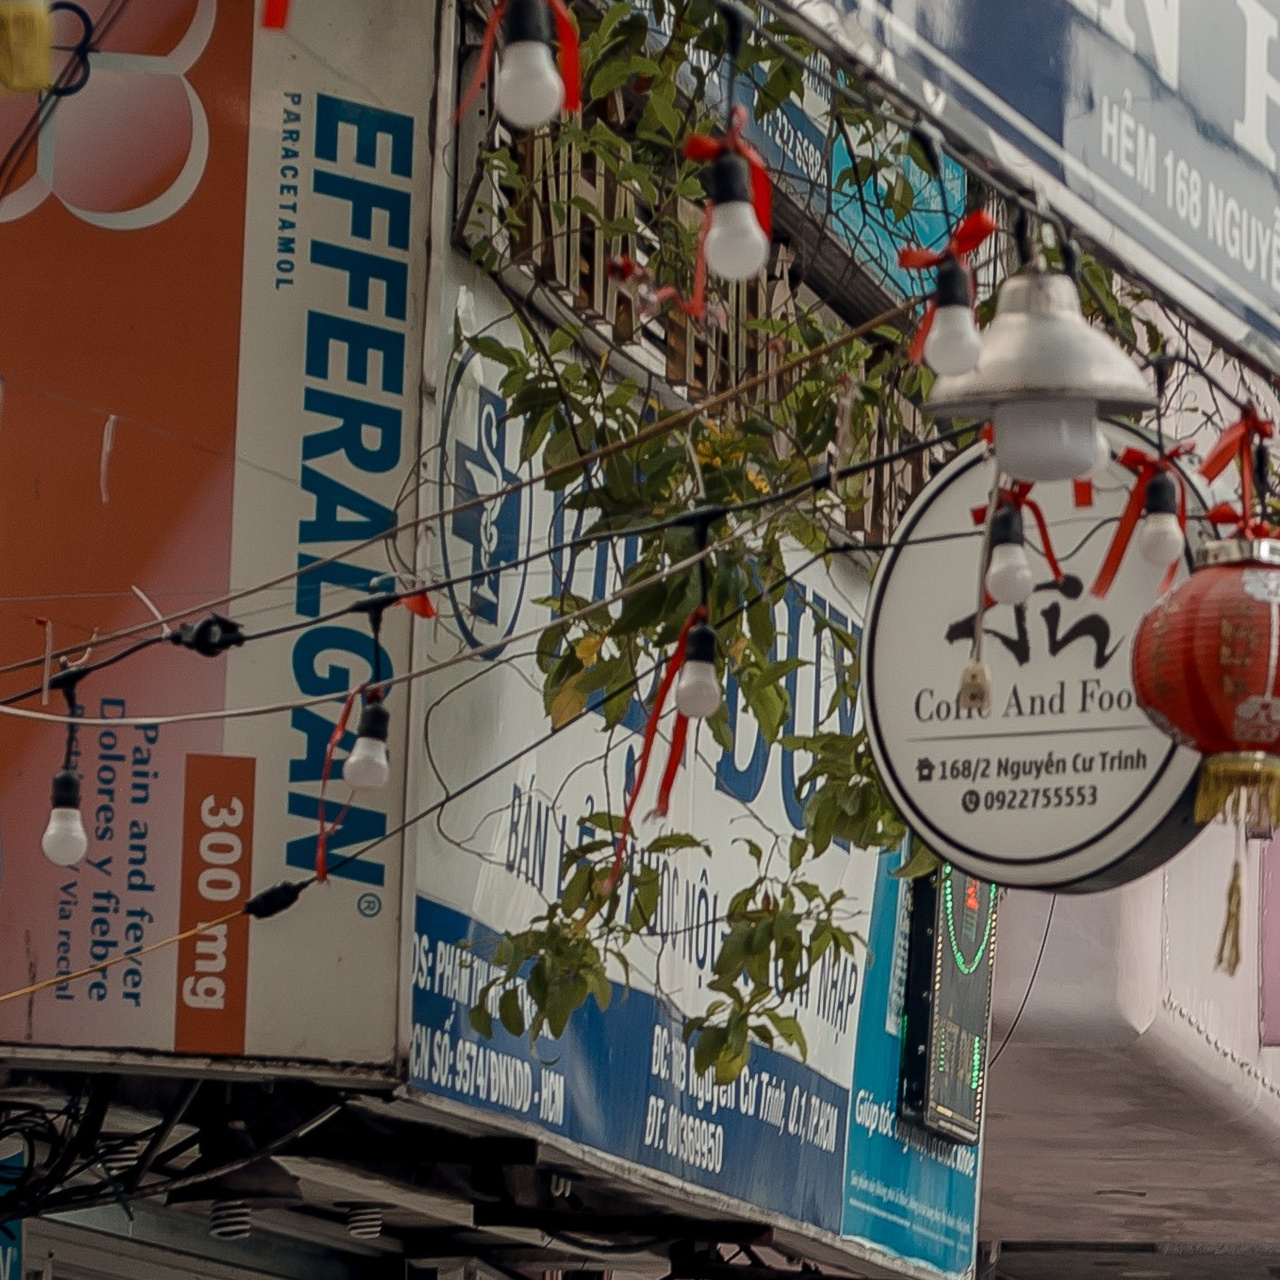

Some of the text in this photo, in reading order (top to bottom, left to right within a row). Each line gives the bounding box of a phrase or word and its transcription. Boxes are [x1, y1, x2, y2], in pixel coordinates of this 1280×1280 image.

[274, 91, 302, 291] PARACETAMOL
[1101, 88, 1157, 194] HẺM
[1163, 150, 1203, 230] 168
[285, 93, 414, 887] EFFERALGAN
[1003, 681, 1066, 718] And
[1079, 678, 1134, 713] Foo
[939, 758, 992, 783] 168/2
[1072, 752, 1096, 773] Cư
[983, 786, 1098, 811] 0922755553
[86, 697, 127, 1003] Dolores y fiebre
[121, 719, 160, 1008] Pain and fever
[505, 774, 551, 892] BÁN
[182, 794, 245, 1011] 300 mg
[54, 929, 77, 1001] rectal
[651, 1024, 670, 1081] ĐC:
[644, 1095, 667, 1150] ĐT:
